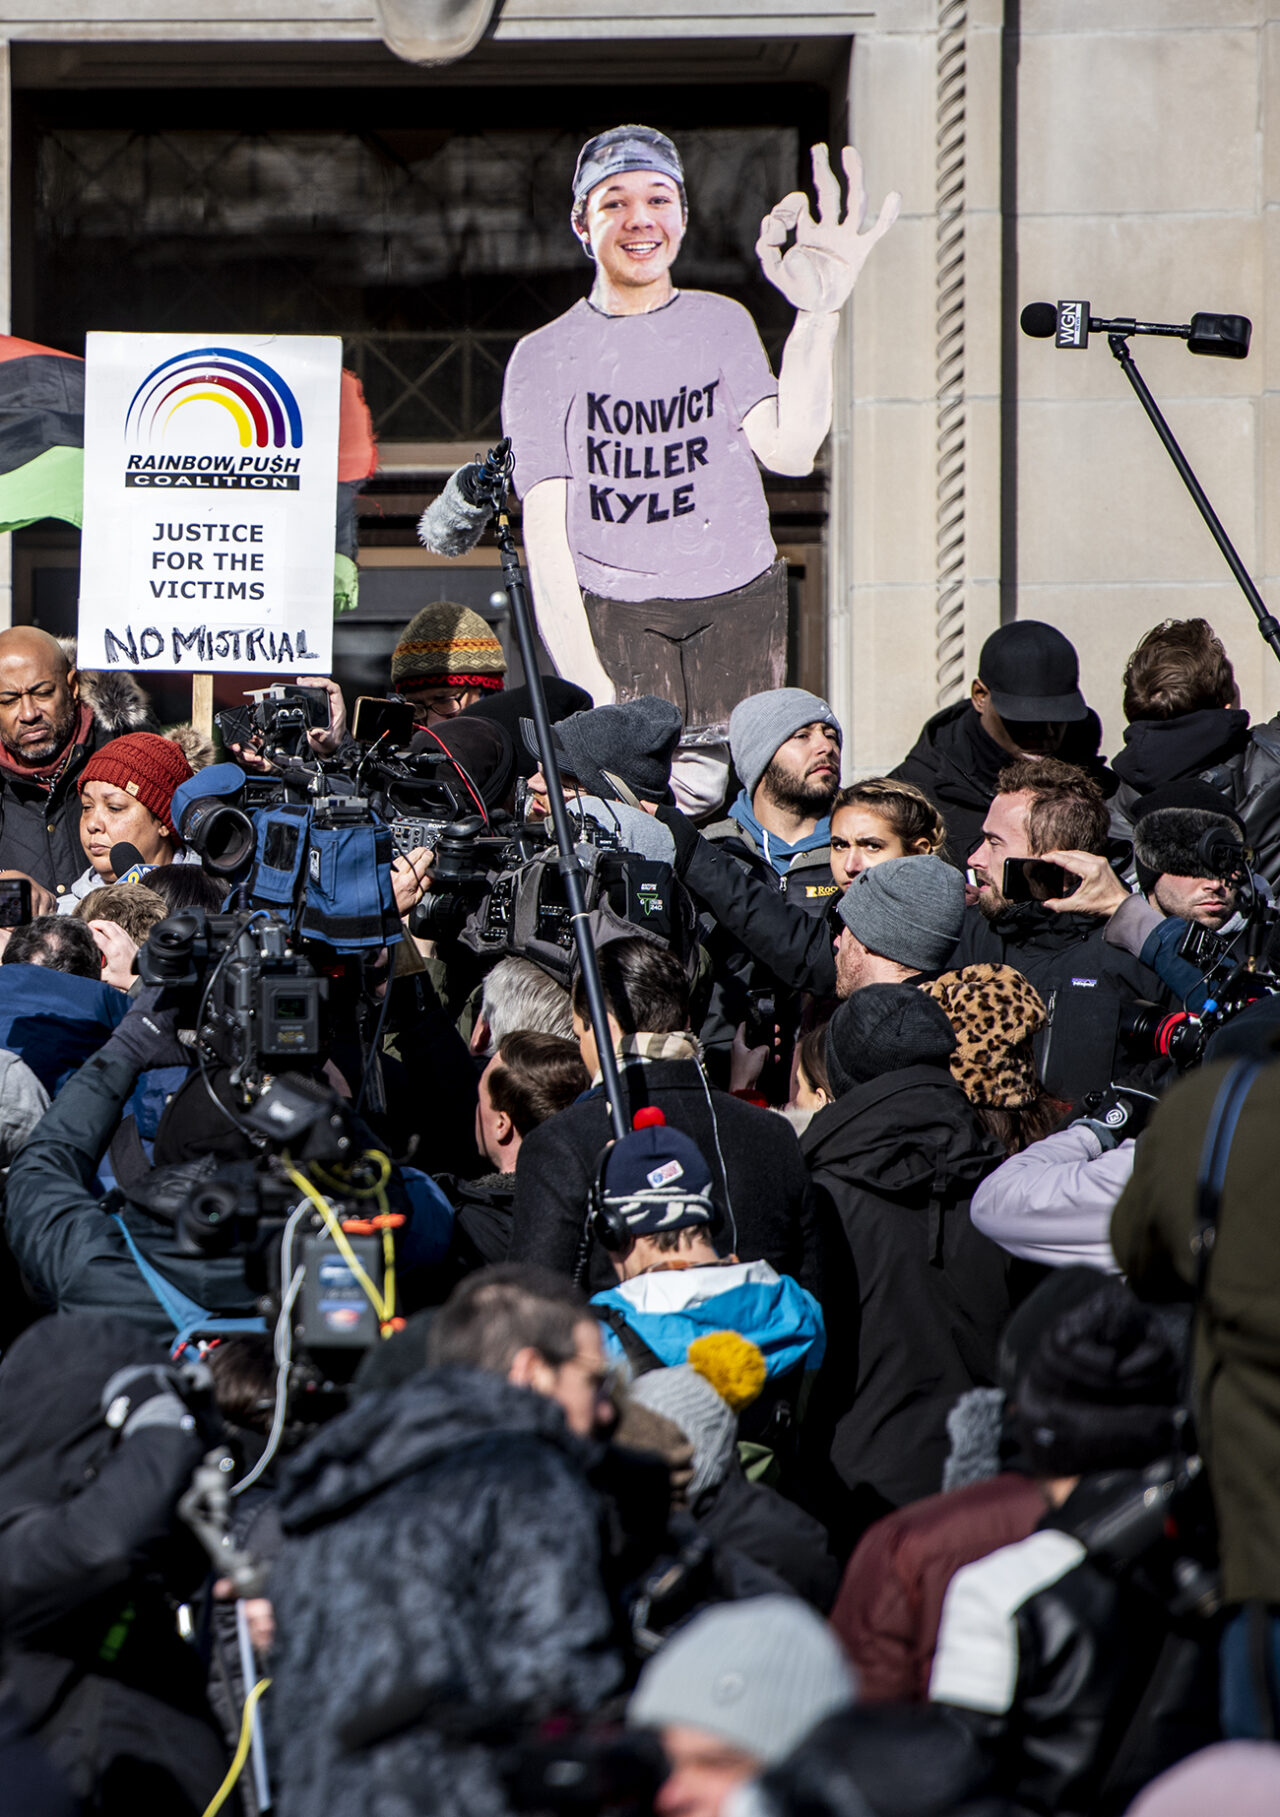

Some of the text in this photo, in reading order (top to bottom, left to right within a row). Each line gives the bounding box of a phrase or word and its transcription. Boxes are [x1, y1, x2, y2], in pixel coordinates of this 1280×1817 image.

[1060, 303, 1076, 344] WGN
[127, 455, 234, 472] RAINBOW
[134, 475, 288, 488] COALITION
[589, 483, 696, 524] KYLE
[152, 523, 263, 542] JUSTICE
[152, 552, 264, 571] FOR THE
[149, 580, 265, 600] VICTIMS
[104, 624, 320, 665] NO MISTRIAL
